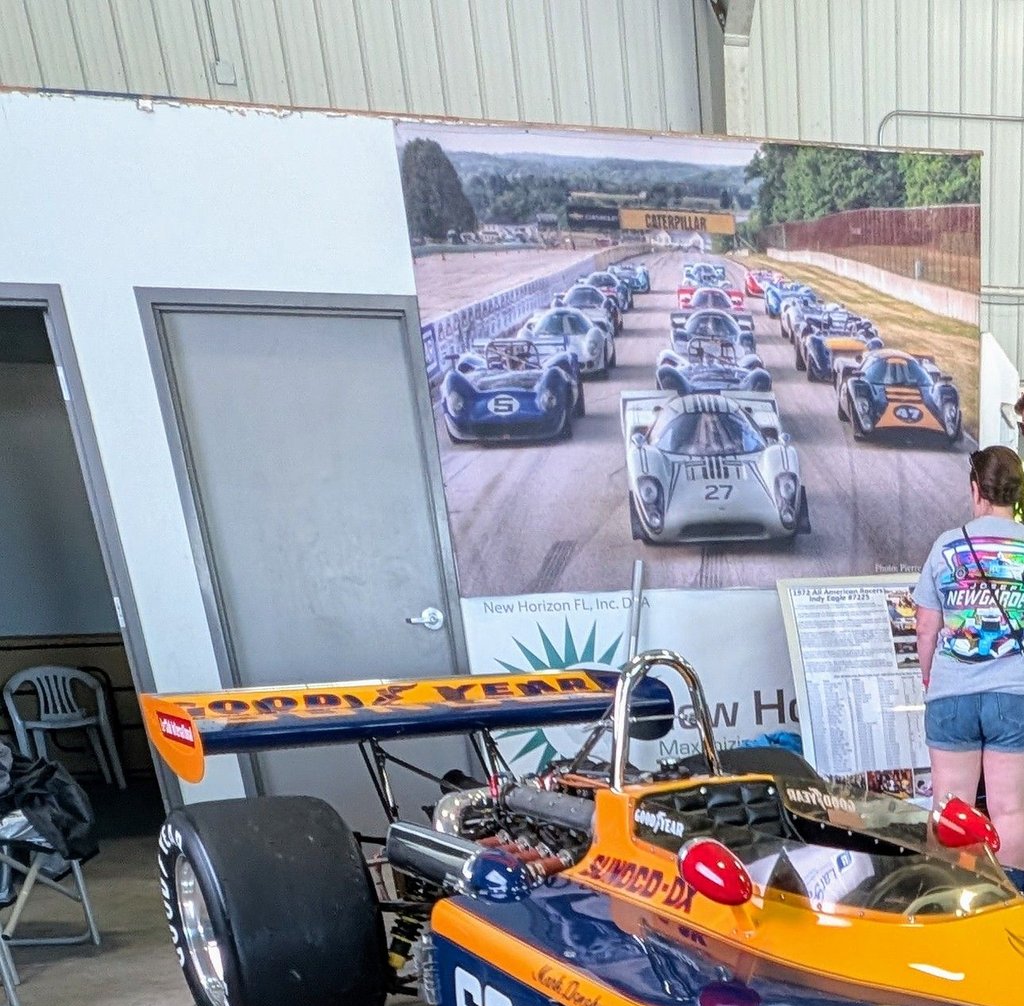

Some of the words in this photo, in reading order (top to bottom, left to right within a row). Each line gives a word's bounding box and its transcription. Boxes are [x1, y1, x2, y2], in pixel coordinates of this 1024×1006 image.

[645, 214, 707, 231] CATERPILLAR
[494, 397, 514, 413] 5
[704, 485, 734, 501] 27
[483, 601, 514, 614] New
[517, 599, 571, 613] Horizon
[574, 598, 593, 612] FL,
[595, 597, 619, 610] Inc.
[621, 596, 651, 610] DA
[634, 807, 685, 838] GOODYEAR
[589, 854, 698, 914] SUNOCO-DX
